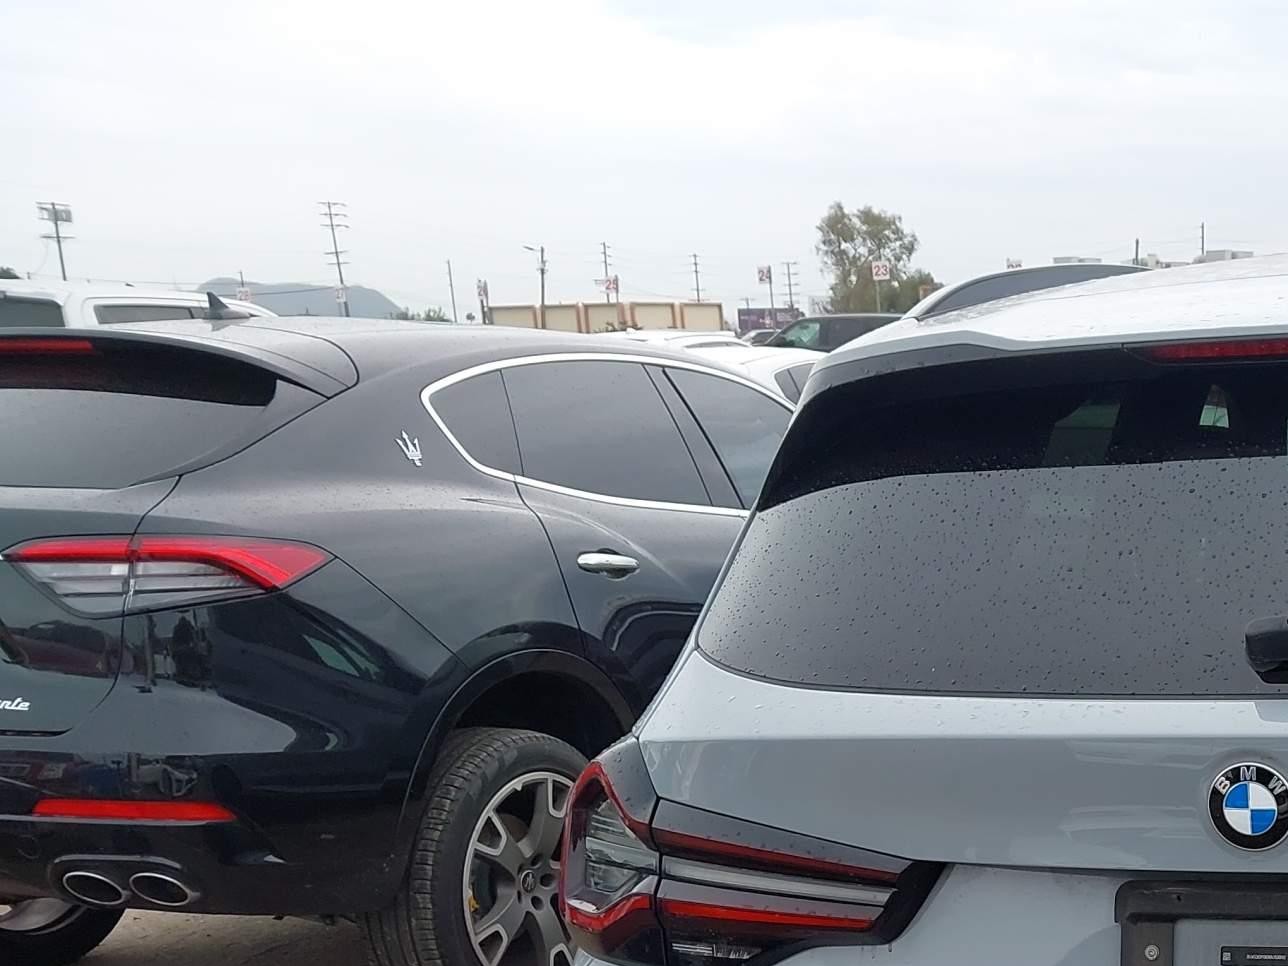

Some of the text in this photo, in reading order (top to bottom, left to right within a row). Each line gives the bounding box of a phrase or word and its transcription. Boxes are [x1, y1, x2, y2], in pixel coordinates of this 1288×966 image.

[873, 264, 889, 277] 23
[0, 697, 31, 711] nte
[1215, 765, 1288, 797] BMW
